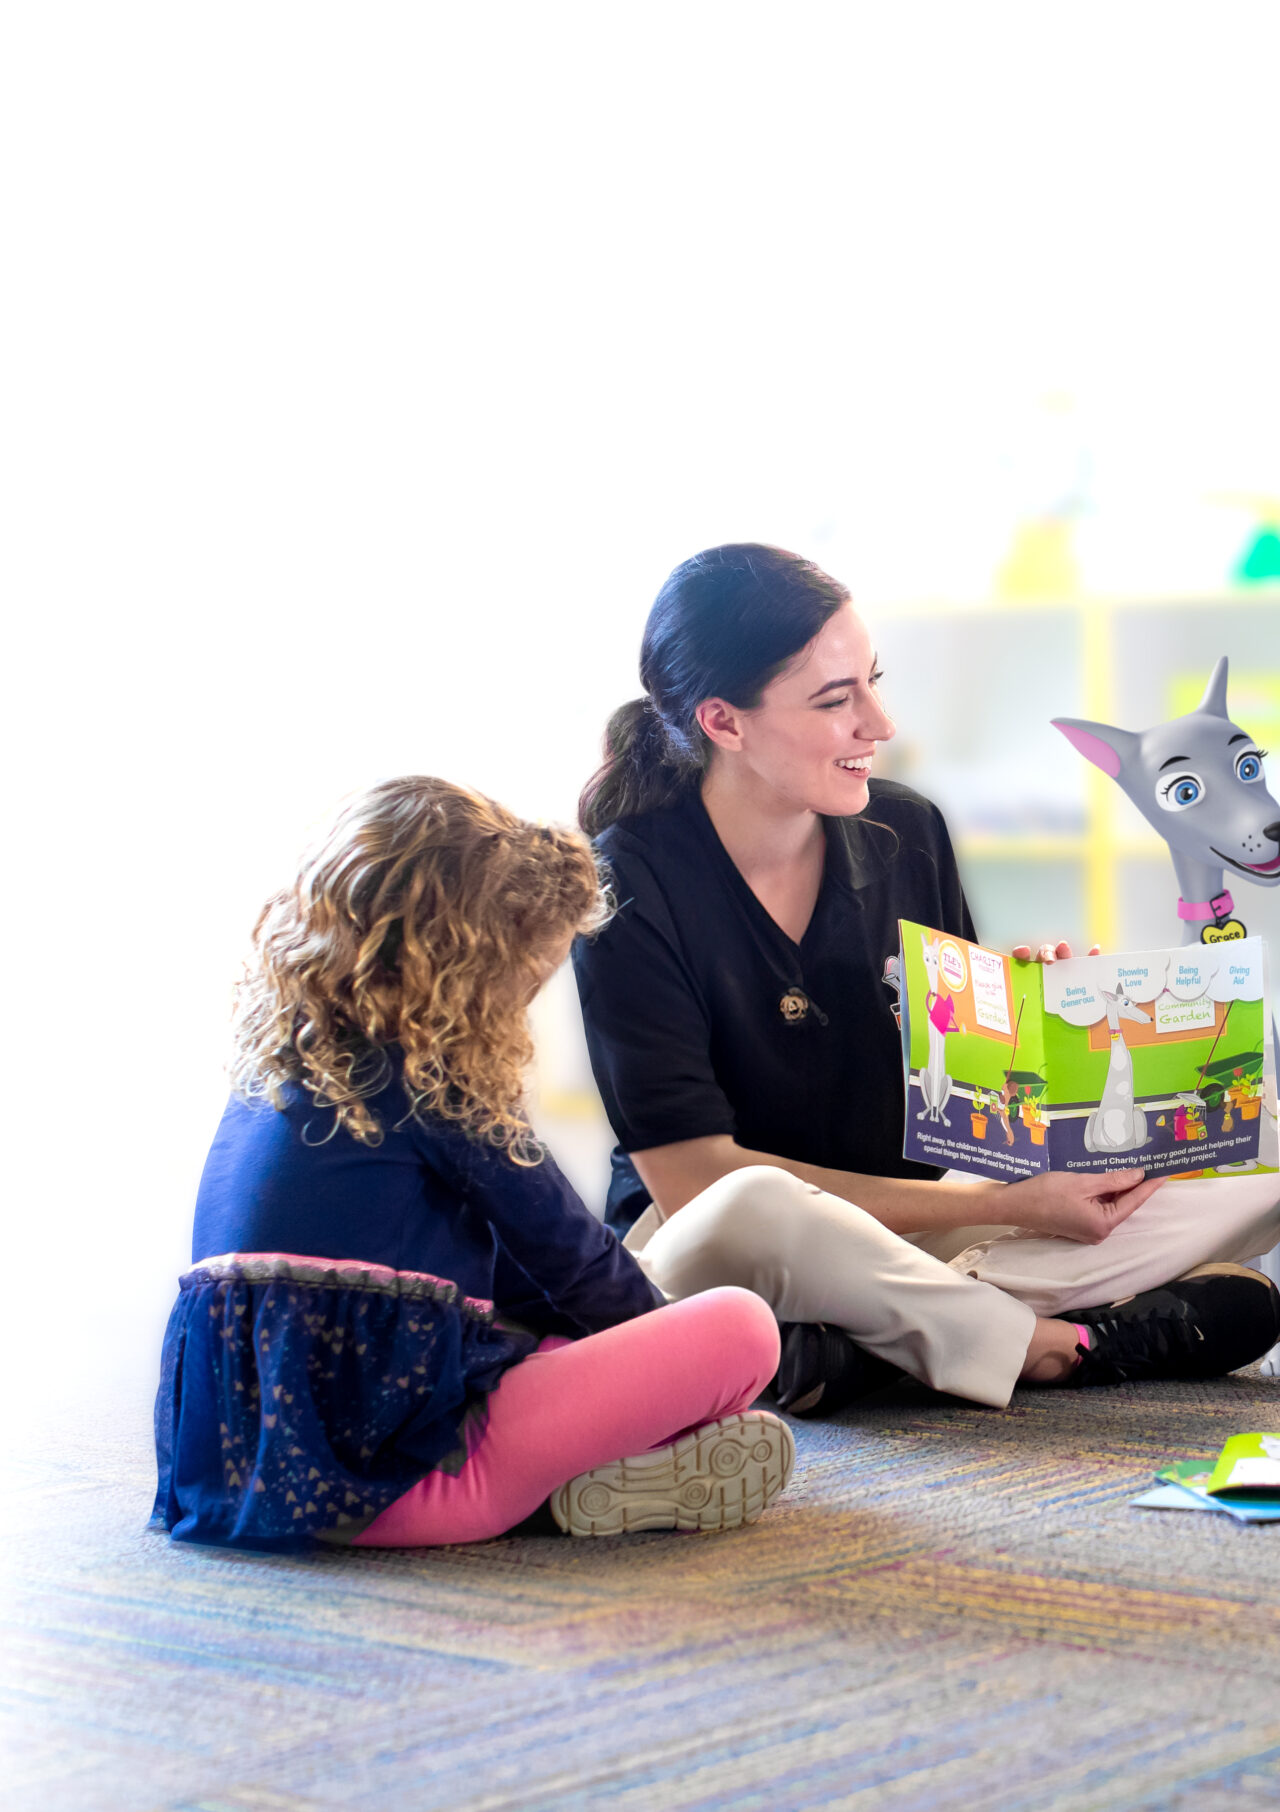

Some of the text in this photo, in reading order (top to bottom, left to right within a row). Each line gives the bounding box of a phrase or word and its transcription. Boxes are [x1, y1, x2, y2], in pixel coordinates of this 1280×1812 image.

[1209, 931, 1241, 944] Grace
[970, 951, 1002, 969] CHARITY
[1117, 967, 1149, 978] Showing
[1178, 966, 1199, 976] Being
[1229, 966, 1250, 977] Giving
[1125, 978, 1142, 988] Love
[1176, 975, 1201, 987] Helpful
[1233, 976, 1245, 985] Aid
[1065, 986, 1087, 997] Being
[1060, 996, 1095, 1009] Generous
[1158, 999, 1212, 1011] Community
[1159, 1010, 1211, 1025] Garden
[917, 1131, 931, 1142] Right
[947, 1140, 956, 1148] the
[956, 1142, 978, 1152] children
[978, 1146, 992, 1156] began
[993, 1151, 1014, 1164] collecting
[1030, 1160, 1041, 1168] and
[1066, 1135, 1252, 1168] Grace and Charity felt very good about helping their
[923, 1145, 943, 1155] special
[943, 1148, 959, 1159] things
[960, 1152, 972, 1162] they
[972, 1156, 987, 1165] would
[1006, 1164, 1014, 1172] the
[1154, 1161, 1165, 1169] the
[1166, 1157, 1190, 1168] charity
[1190, 1151, 1218, 1163] project.
